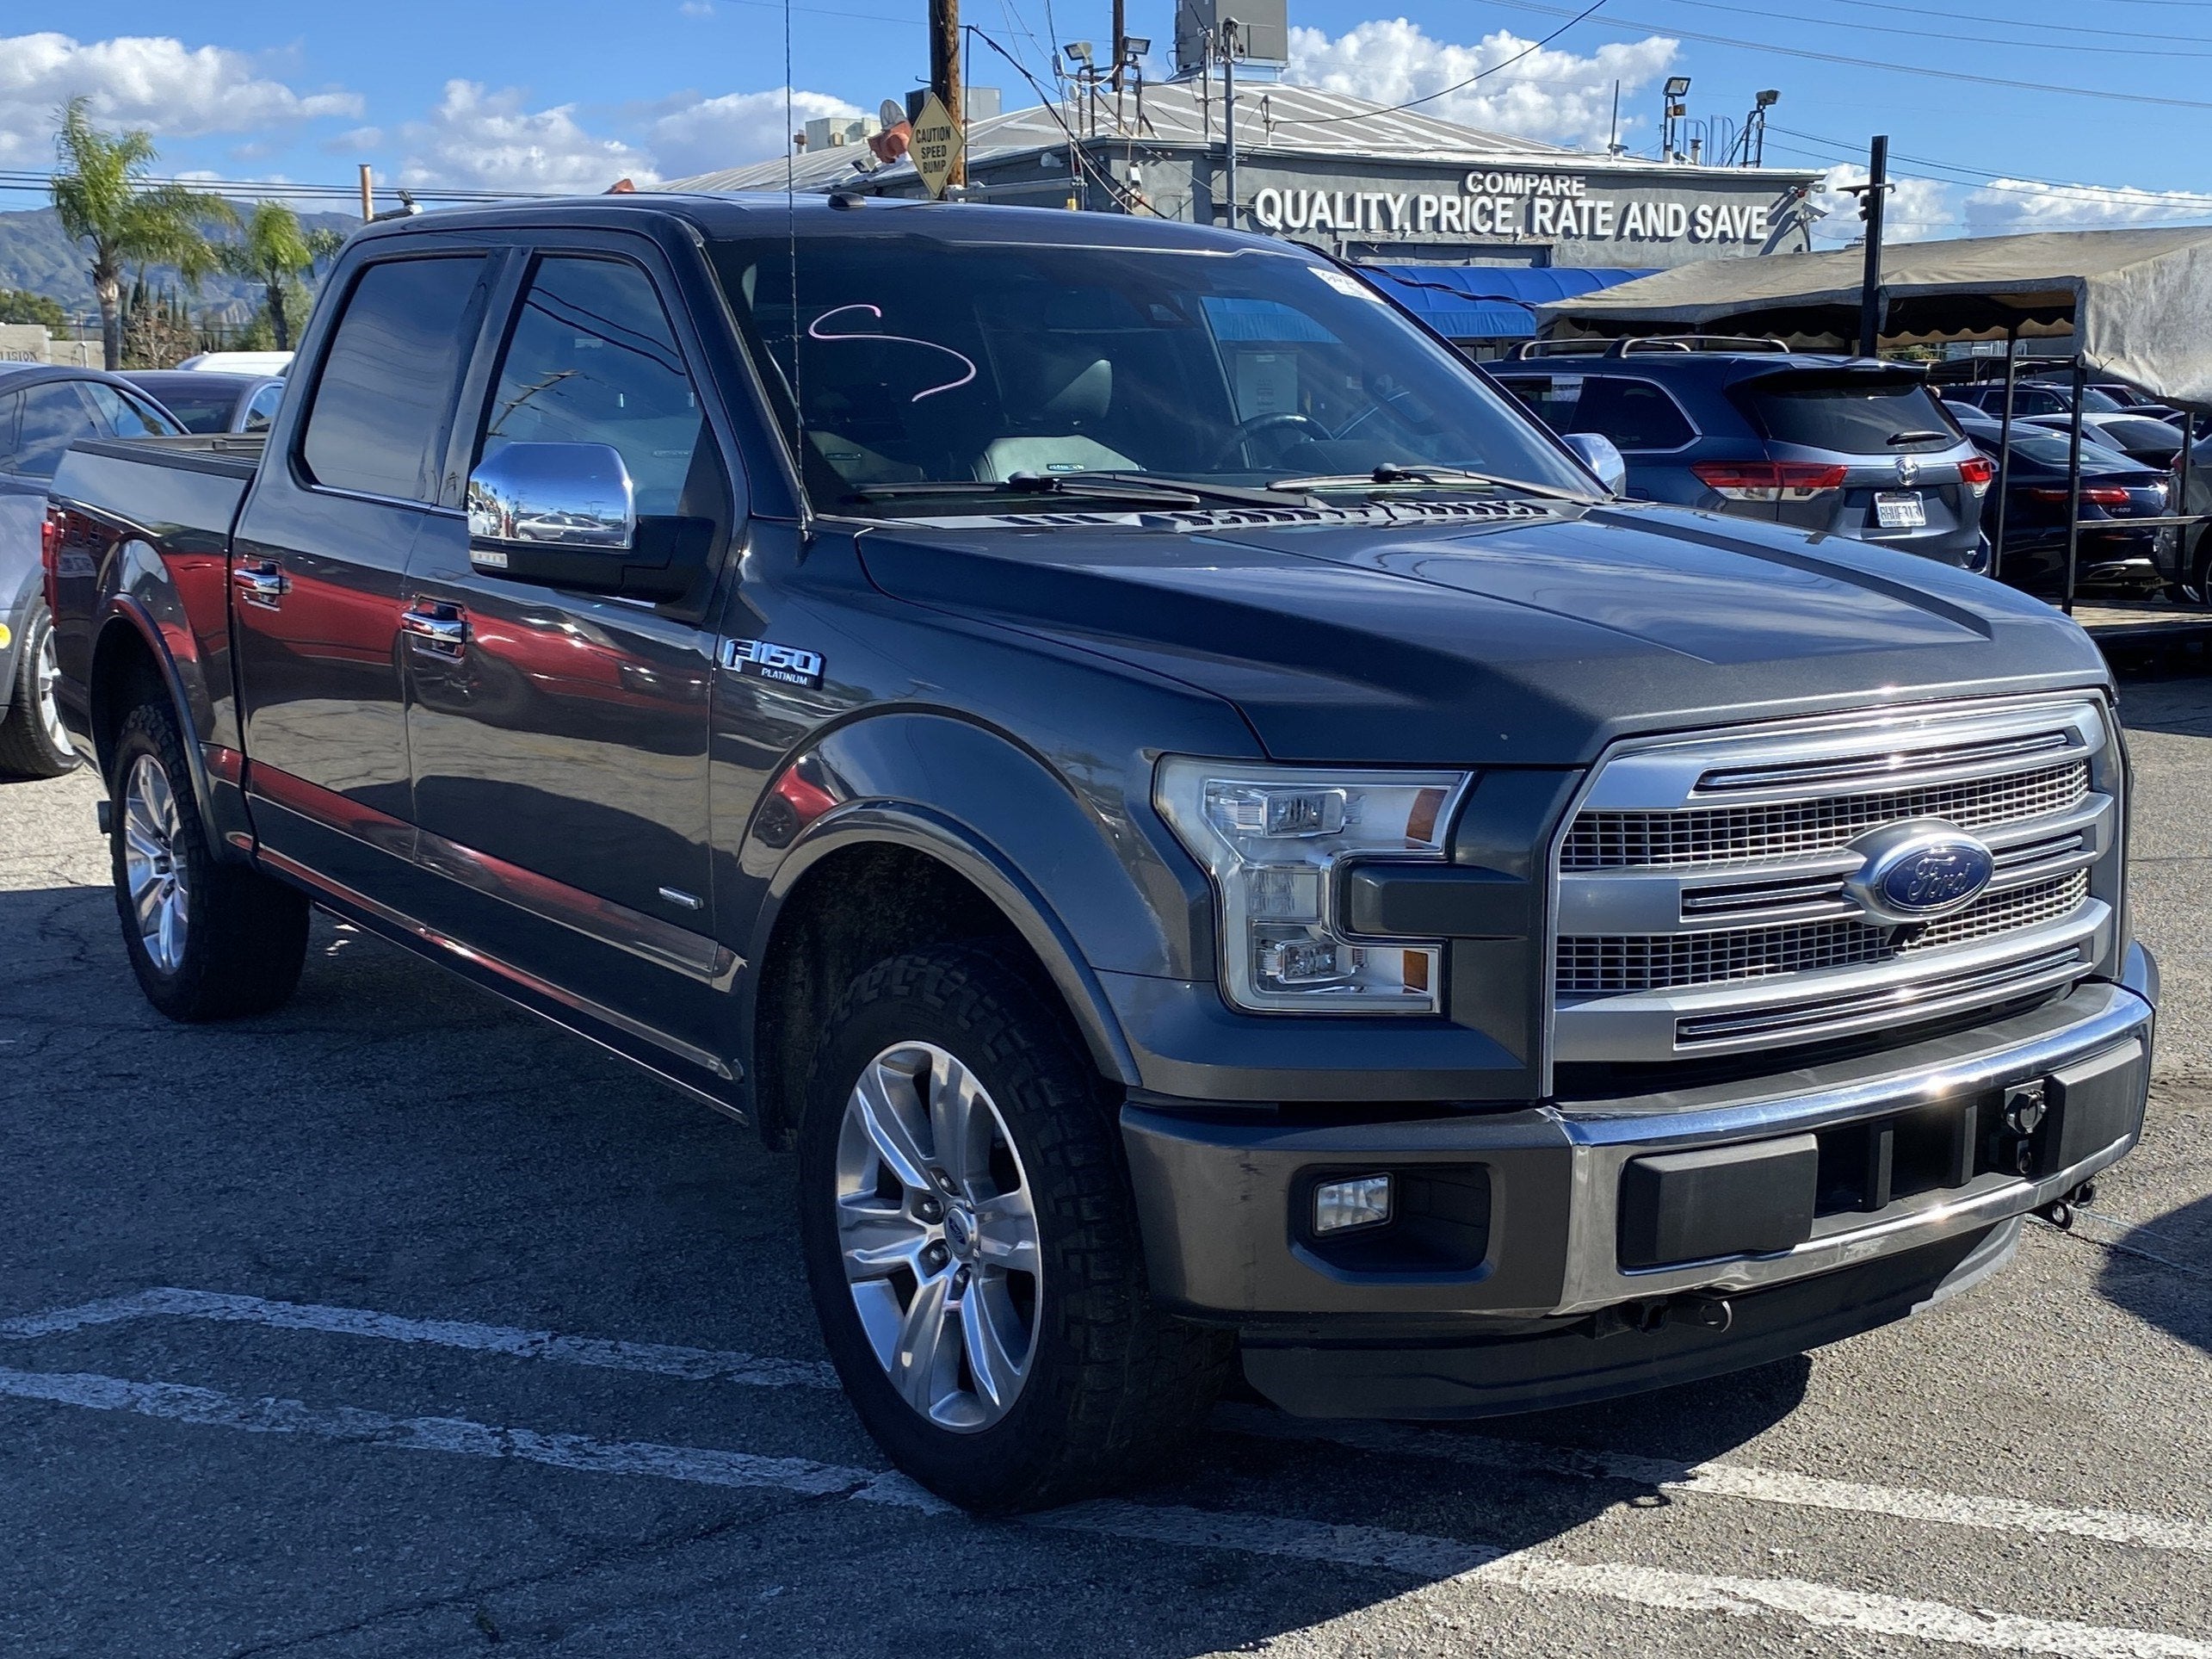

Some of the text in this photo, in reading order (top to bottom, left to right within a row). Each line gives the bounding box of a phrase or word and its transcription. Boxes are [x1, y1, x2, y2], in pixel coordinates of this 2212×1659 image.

[916, 127, 951, 144] CAUTION
[921, 145, 947, 159] SPEED
[923, 159, 947, 174] BUMP
[1464, 171, 1586, 197] COMPARE
[1255, 188, 1769, 242] QUALITY, PRICE, RATE AND SAVE
[761, 667, 808, 685] PLATINUM
[1907, 855, 1971, 902] Ford
